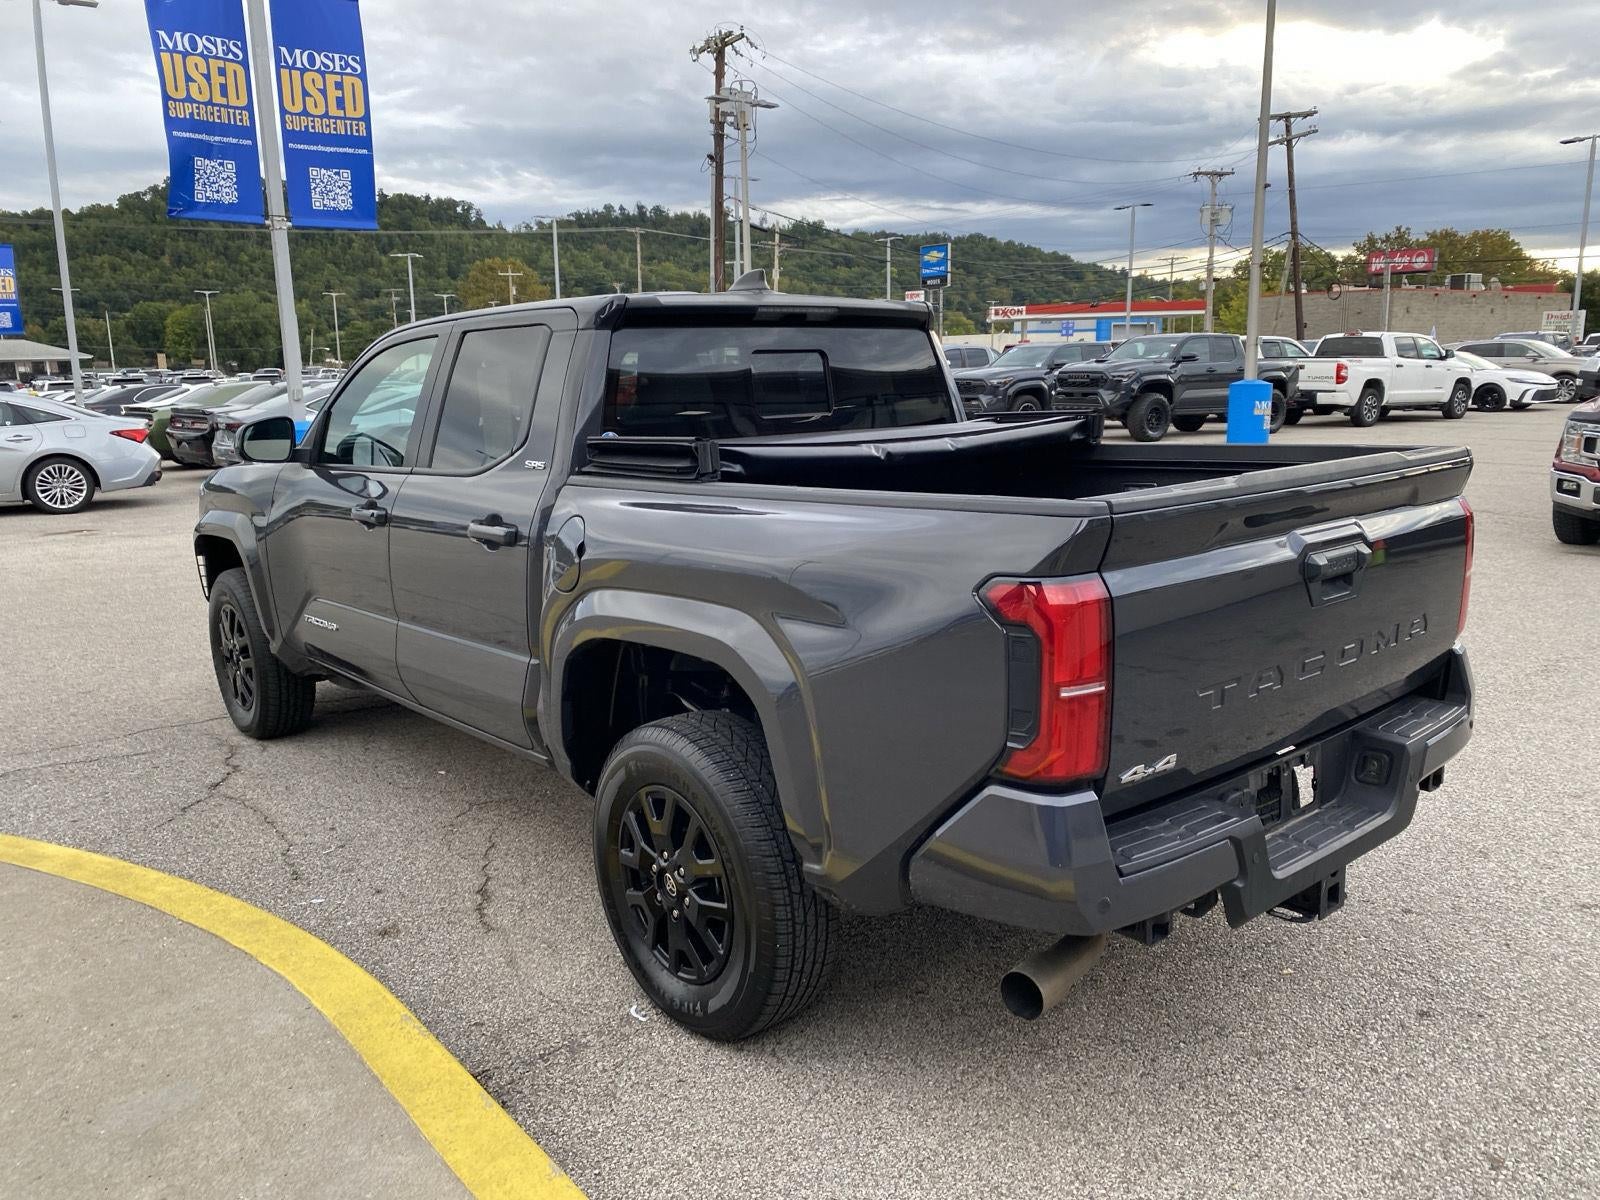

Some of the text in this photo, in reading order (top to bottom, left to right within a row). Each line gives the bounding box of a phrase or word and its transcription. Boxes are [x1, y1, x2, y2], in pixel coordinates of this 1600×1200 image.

[157, 30, 243, 61] MOSES
[279, 46, 362, 74] MOSES
[160, 52, 248, 107] USED
[280, 68, 365, 118] USED
[168, 101, 250, 126] SUPERCENTER
[285, 114, 367, 136] SUPERCENTER
[172, 130, 253, 146] mosesusedsupercenter.com
[288, 143, 368, 155] mosesusedsupercenter.com
[994, 307, 1024, 318] EXXON
[303, 614, 337, 631] TACOMA
[1195, 612, 1429, 710] TACOMA
